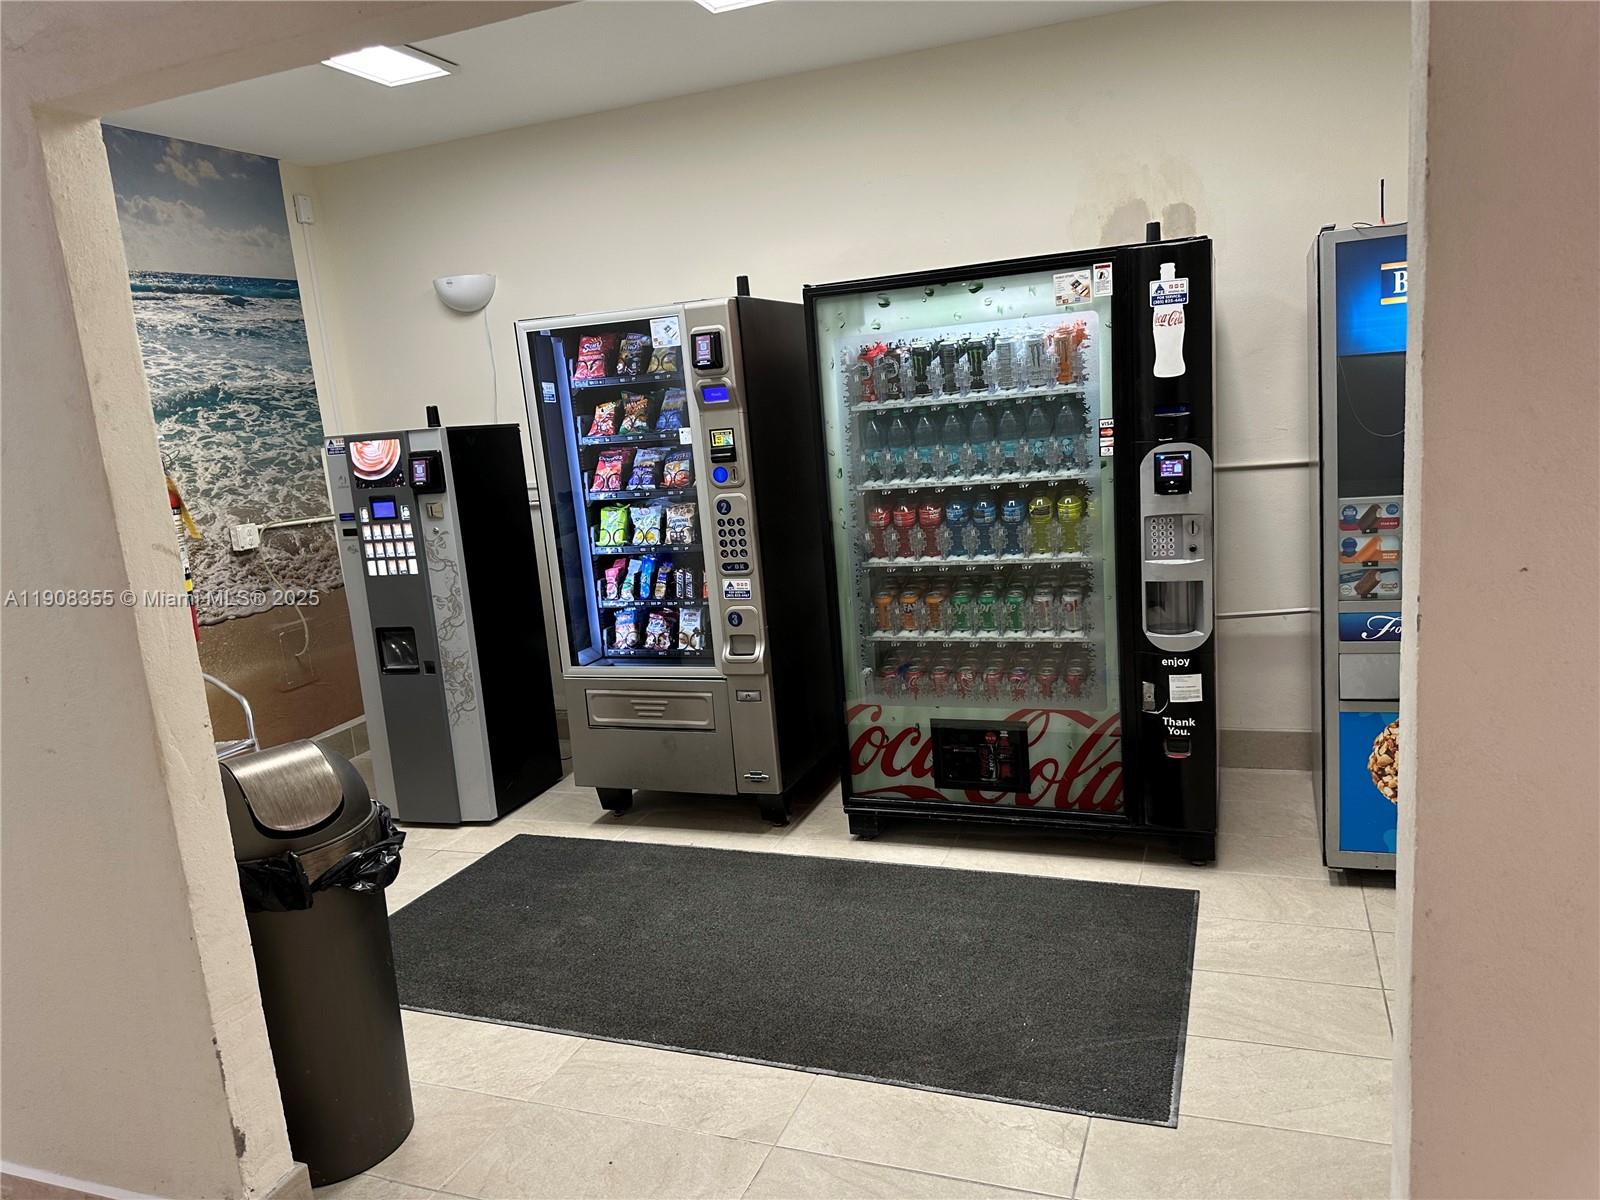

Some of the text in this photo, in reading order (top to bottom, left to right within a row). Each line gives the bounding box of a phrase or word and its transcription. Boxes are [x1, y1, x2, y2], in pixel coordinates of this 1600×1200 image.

[720, 502, 728, 514] 2
[731, 614, 738, 625] 3
[1161, 656, 1190, 668] enjoy
[1162, 716, 1196, 727] Thank
[1167, 726, 1191, 736] You.
[966, 707, 1124, 812] Cola
